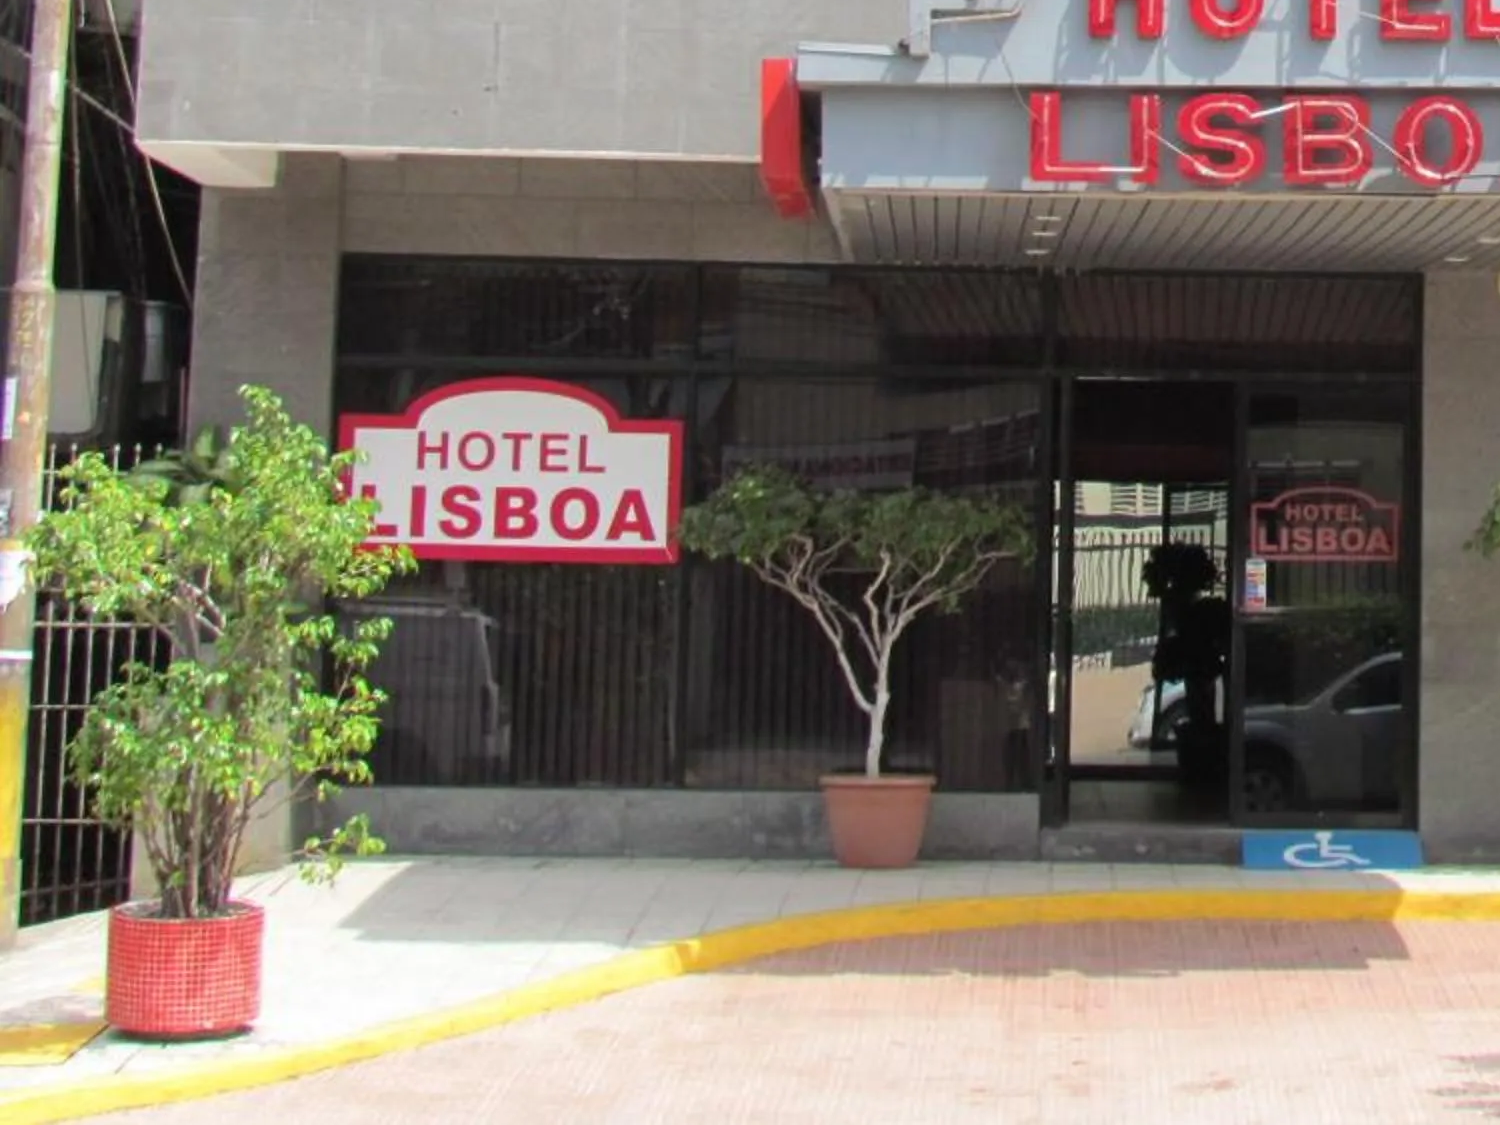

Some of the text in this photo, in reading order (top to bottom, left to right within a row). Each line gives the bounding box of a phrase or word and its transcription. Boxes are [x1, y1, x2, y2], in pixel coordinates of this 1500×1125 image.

[416, 430, 606, 473] HOTEL
[361, 483, 656, 541] LISBOA
[1285, 503, 1364, 523] HOTEL
[1259, 526, 1390, 554] LISBOA
